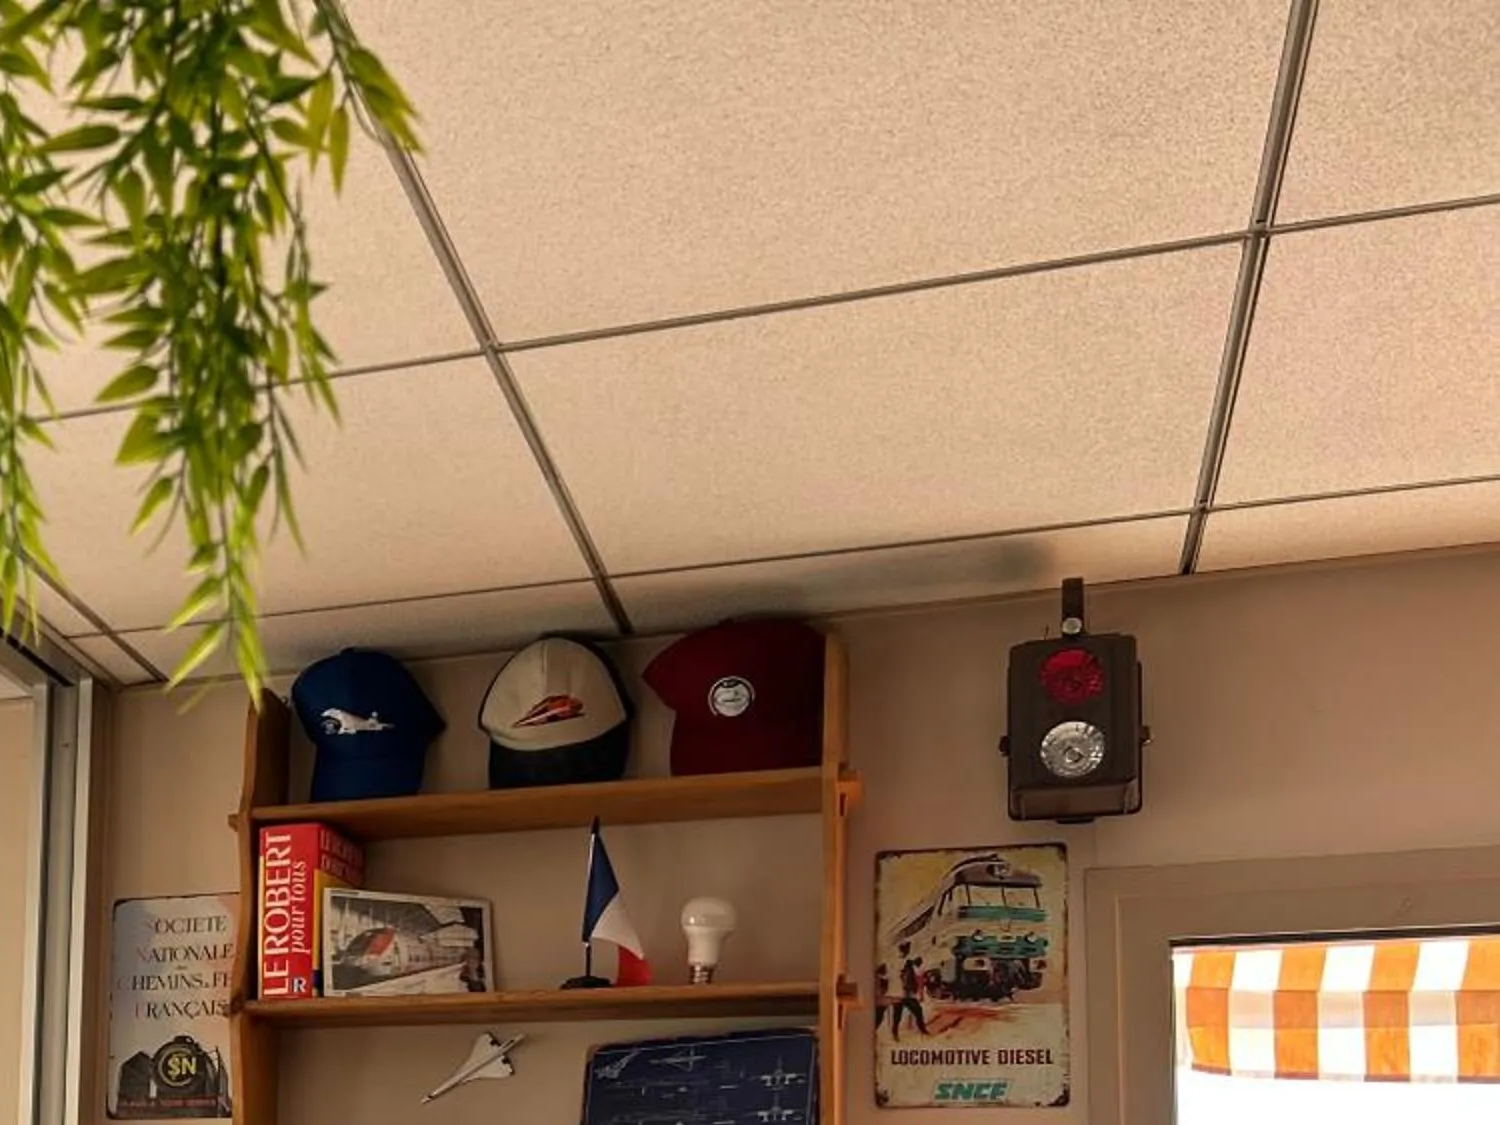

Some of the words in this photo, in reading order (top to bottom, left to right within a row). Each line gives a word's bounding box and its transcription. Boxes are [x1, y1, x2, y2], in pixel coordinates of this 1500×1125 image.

[264, 832, 292, 954] ROBERT
[291, 861, 307, 902] tous
[291, 907, 310, 954] pour
[136, 943, 233, 963] NATIONALE
[263, 959, 289, 995] LE
[891, 1049, 990, 1065] LOCOMOTIVE
[997, 1049, 1054, 1064] DIESEL
[934, 1081, 1009, 1100] SNCF
